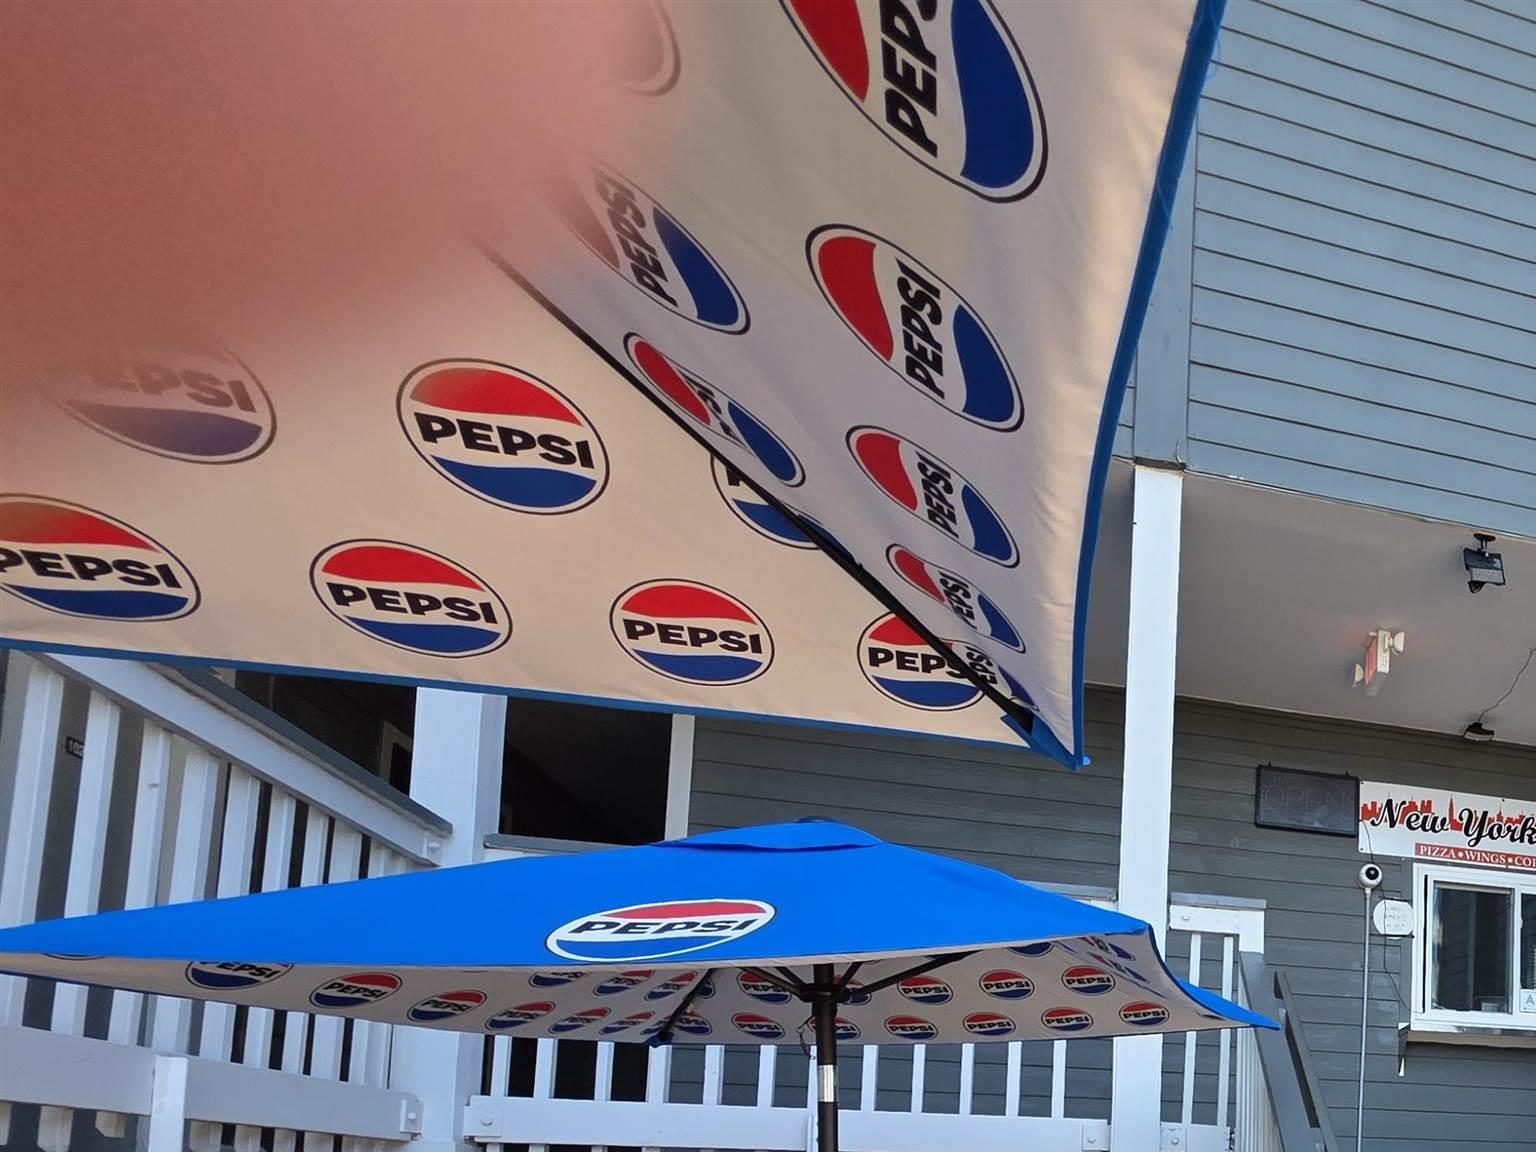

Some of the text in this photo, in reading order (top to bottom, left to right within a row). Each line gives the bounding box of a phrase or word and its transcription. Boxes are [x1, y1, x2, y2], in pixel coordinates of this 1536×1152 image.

[880, 0, 938, 158] PEP
[895, 257, 945, 400] PEPSI
[413, 412, 595, 469] PEPSI
[914, 450, 960, 539] PEPSI
[326, 582, 499, 625] PEPSI
[622, 618, 763, 654] PEPSI
[1371, 798, 1449, 834] New
[1420, 845, 1457, 860] PIZZA
[1463, 850, 1507, 865] WINGS
[568, 918, 760, 935] PEPSI
[984, 981, 1030, 990] PEPSI
[1066, 977, 1111, 985] PEPSI
[324, 982, 388, 999] PEPSI
[902, 986, 949, 994] PEPSI
[422, 999, 472, 1012] PEPSI
[1123, 1010, 1166, 1018] PEPSI
[888, 1025, 933, 1033] PEPSI
[967, 1021, 1012, 1030] PEPSI
[1045, 1016, 1089, 1025] PEPSI
